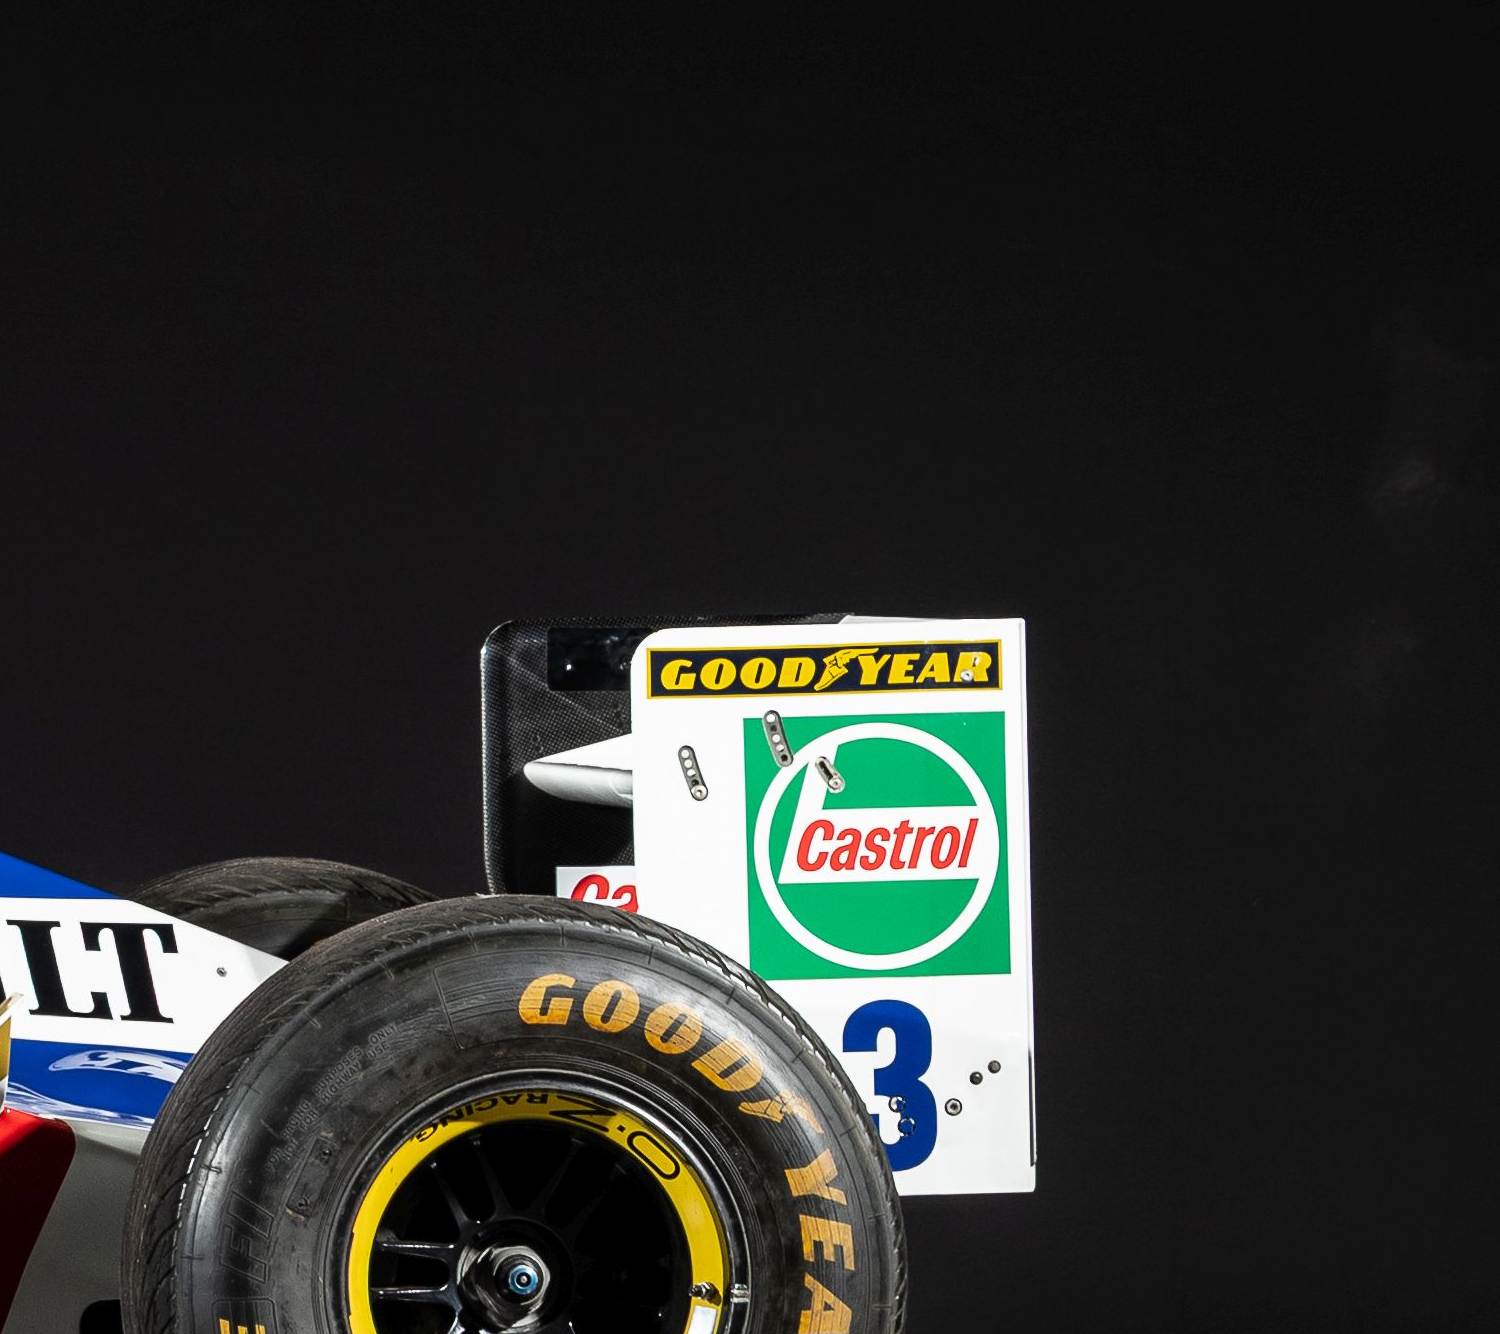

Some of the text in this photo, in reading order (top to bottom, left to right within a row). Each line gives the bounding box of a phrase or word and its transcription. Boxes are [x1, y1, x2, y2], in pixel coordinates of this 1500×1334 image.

[661, 649, 992, 691] GOODYEAR
[796, 818, 979, 872] Castrol
[367, 1021, 399, 1046] ONLY
[842, 999, 938, 1172] 3
[415, 1092, 549, 1144] RACING
